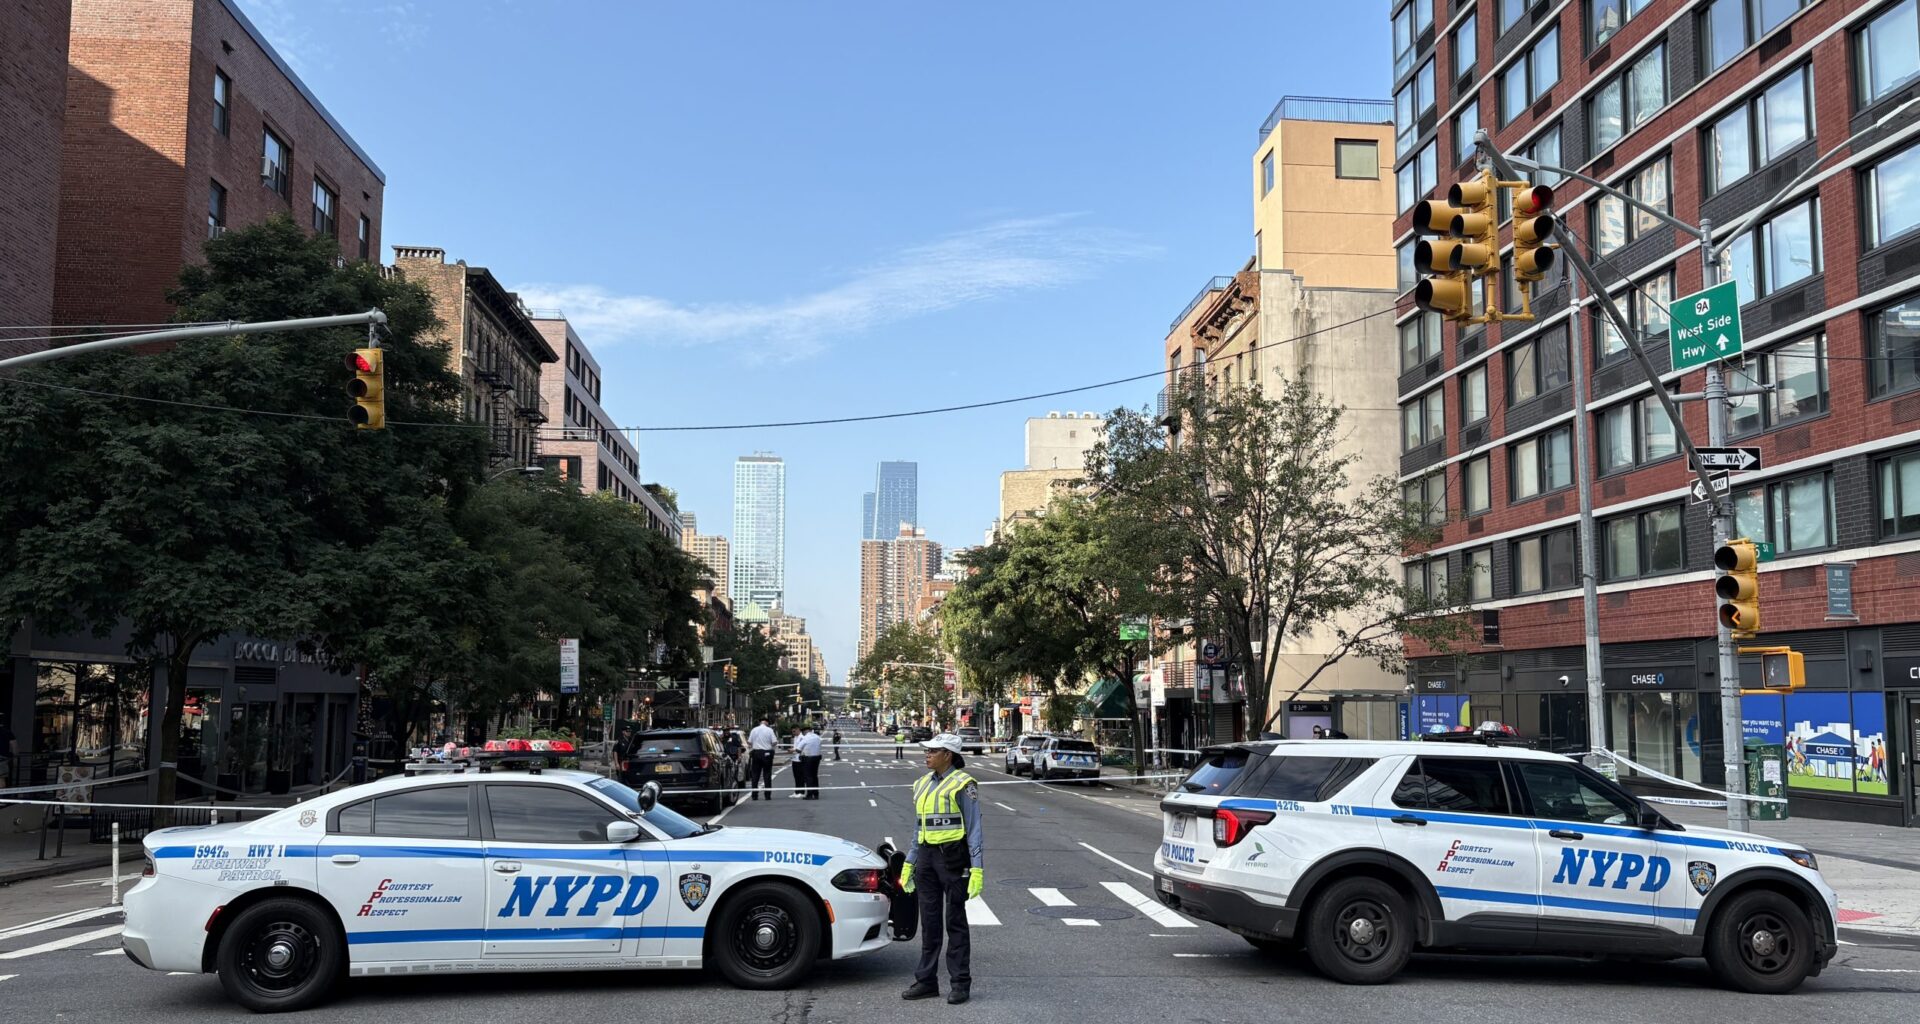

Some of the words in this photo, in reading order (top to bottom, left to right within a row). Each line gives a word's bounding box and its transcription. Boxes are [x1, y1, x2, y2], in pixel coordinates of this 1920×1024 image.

[1697, 301, 1708, 312] 9A
[1678, 322, 1703, 340] West
[1707, 314, 1731, 331] Side
[1682, 344, 1706, 360] Hwy
[1725, 454, 1746, 464] WAY
[1713, 479, 1725, 491] WAY
[1762, 543, 1769, 553] St
[234, 641, 279, 661] BOCCA
[1427, 681, 1442, 689] CHASE
[1631, 674, 1657, 684] CHASE
[1815, 746, 1838, 755] CHASE
[1277, 801, 1299, 811] 4276
[1331, 804, 1351, 815] MTN
[933, 818, 951, 826] PD
[247, 844, 275, 857] HWY
[1451, 839, 1493, 853] COURTESY
[1729, 840, 1767, 853] POLICE
[765, 851, 811, 865] POLICE
[1171, 844, 1195, 863] POLICE
[1444, 850, 1515, 867] PROFESSIONALISM
[192, 858, 272, 870] HIGHWAY
[1437, 861, 1474, 874] RESPECT
[1552, 847, 1671, 892] NYPD
[218, 870, 282, 881] PATROL
[378, 879, 433, 890] COURTESY
[367, 892, 462, 903] PROFESSIONALISM
[498, 875, 660, 917] NYPD
[357, 904, 408, 916] RESPECT
